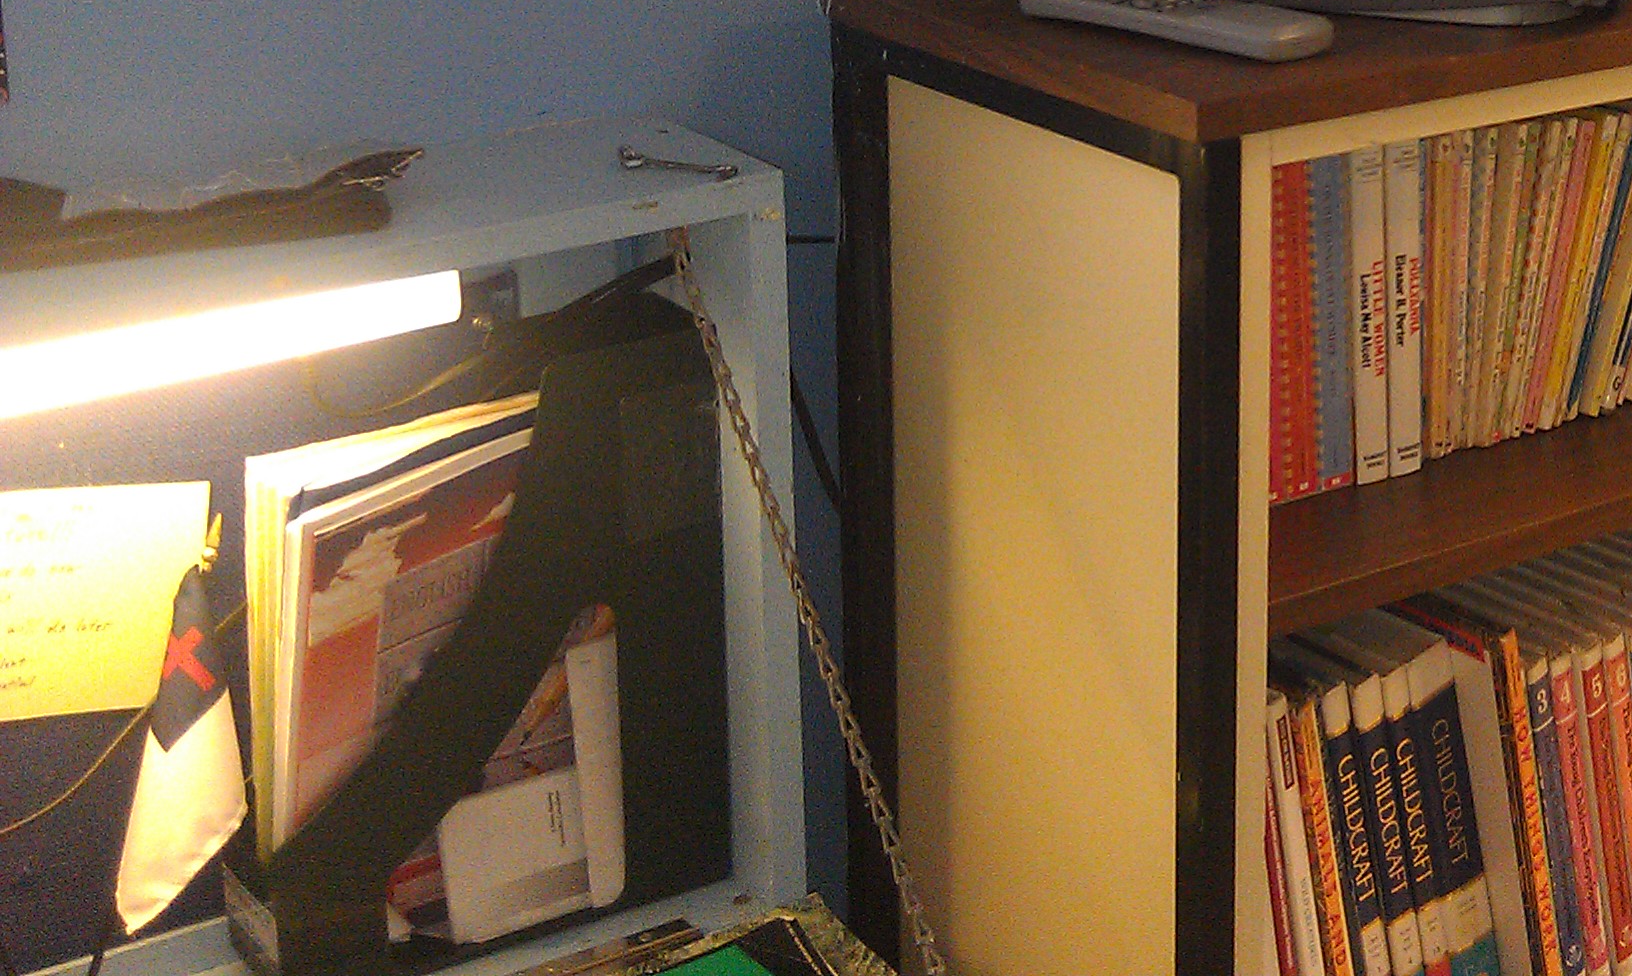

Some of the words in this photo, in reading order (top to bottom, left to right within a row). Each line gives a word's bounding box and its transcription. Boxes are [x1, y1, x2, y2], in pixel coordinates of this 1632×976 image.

[1372, 260, 1384, 316] LITTLE
[1374, 322, 1385, 377] WOMEN
[1536, 688, 1548, 714] 3
[1560, 682, 1571, 706] 4
[1591, 672, 1603, 699] 5
[1615, 663, 1627, 685] 6
[1396, 737, 1434, 882] CHILDCRAFT
[1431, 718, 1470, 865] CHILDCRAFT
[1337, 754, 1376, 902] CHILDCRAFT
[1370, 747, 1409, 894] CHILDCRAFT
